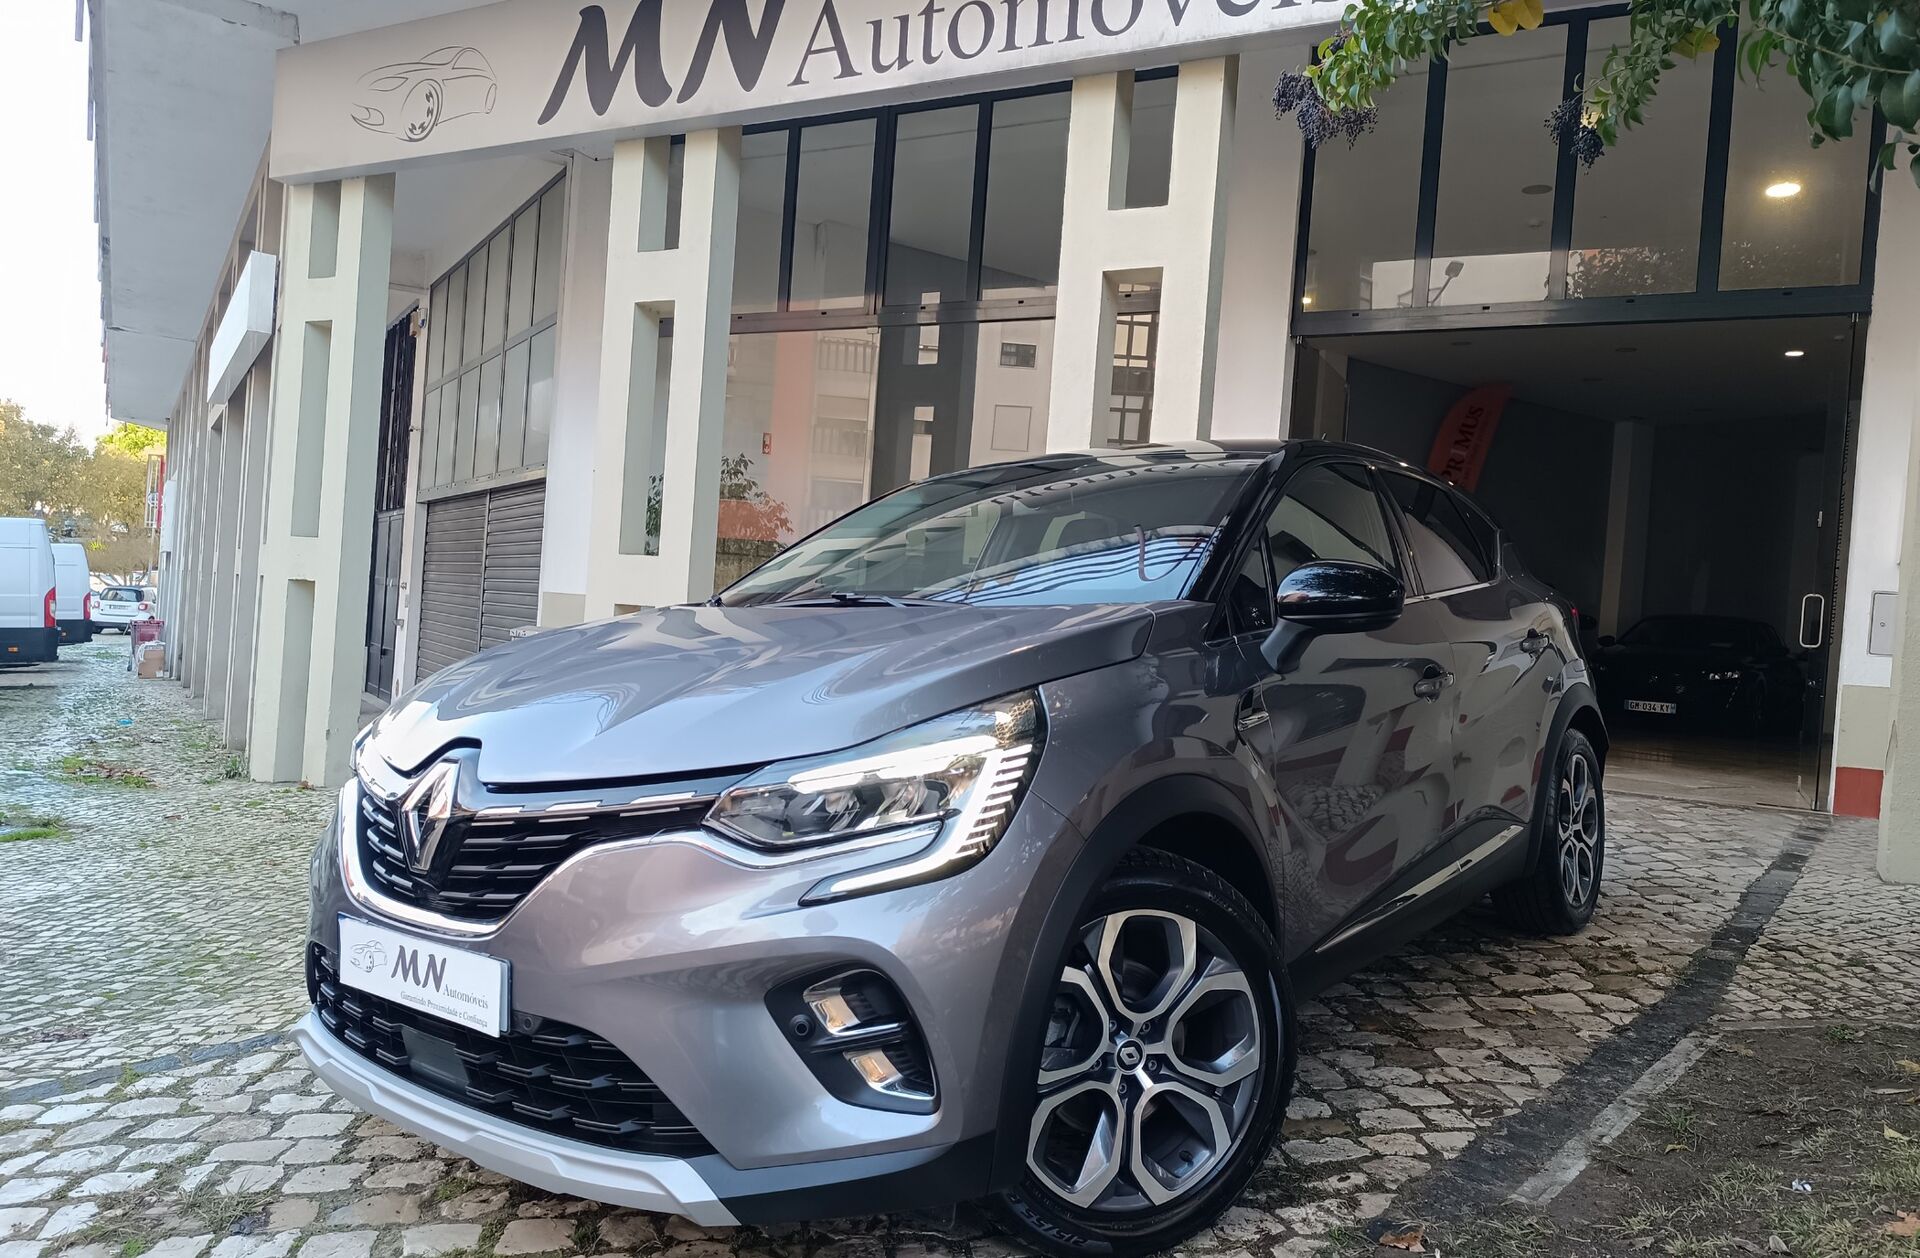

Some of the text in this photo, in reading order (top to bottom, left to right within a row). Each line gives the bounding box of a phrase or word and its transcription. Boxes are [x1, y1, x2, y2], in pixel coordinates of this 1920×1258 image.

[537, 0, 1338, 126] MN Autom
[391, 945, 488, 1009] MN Automóveis
